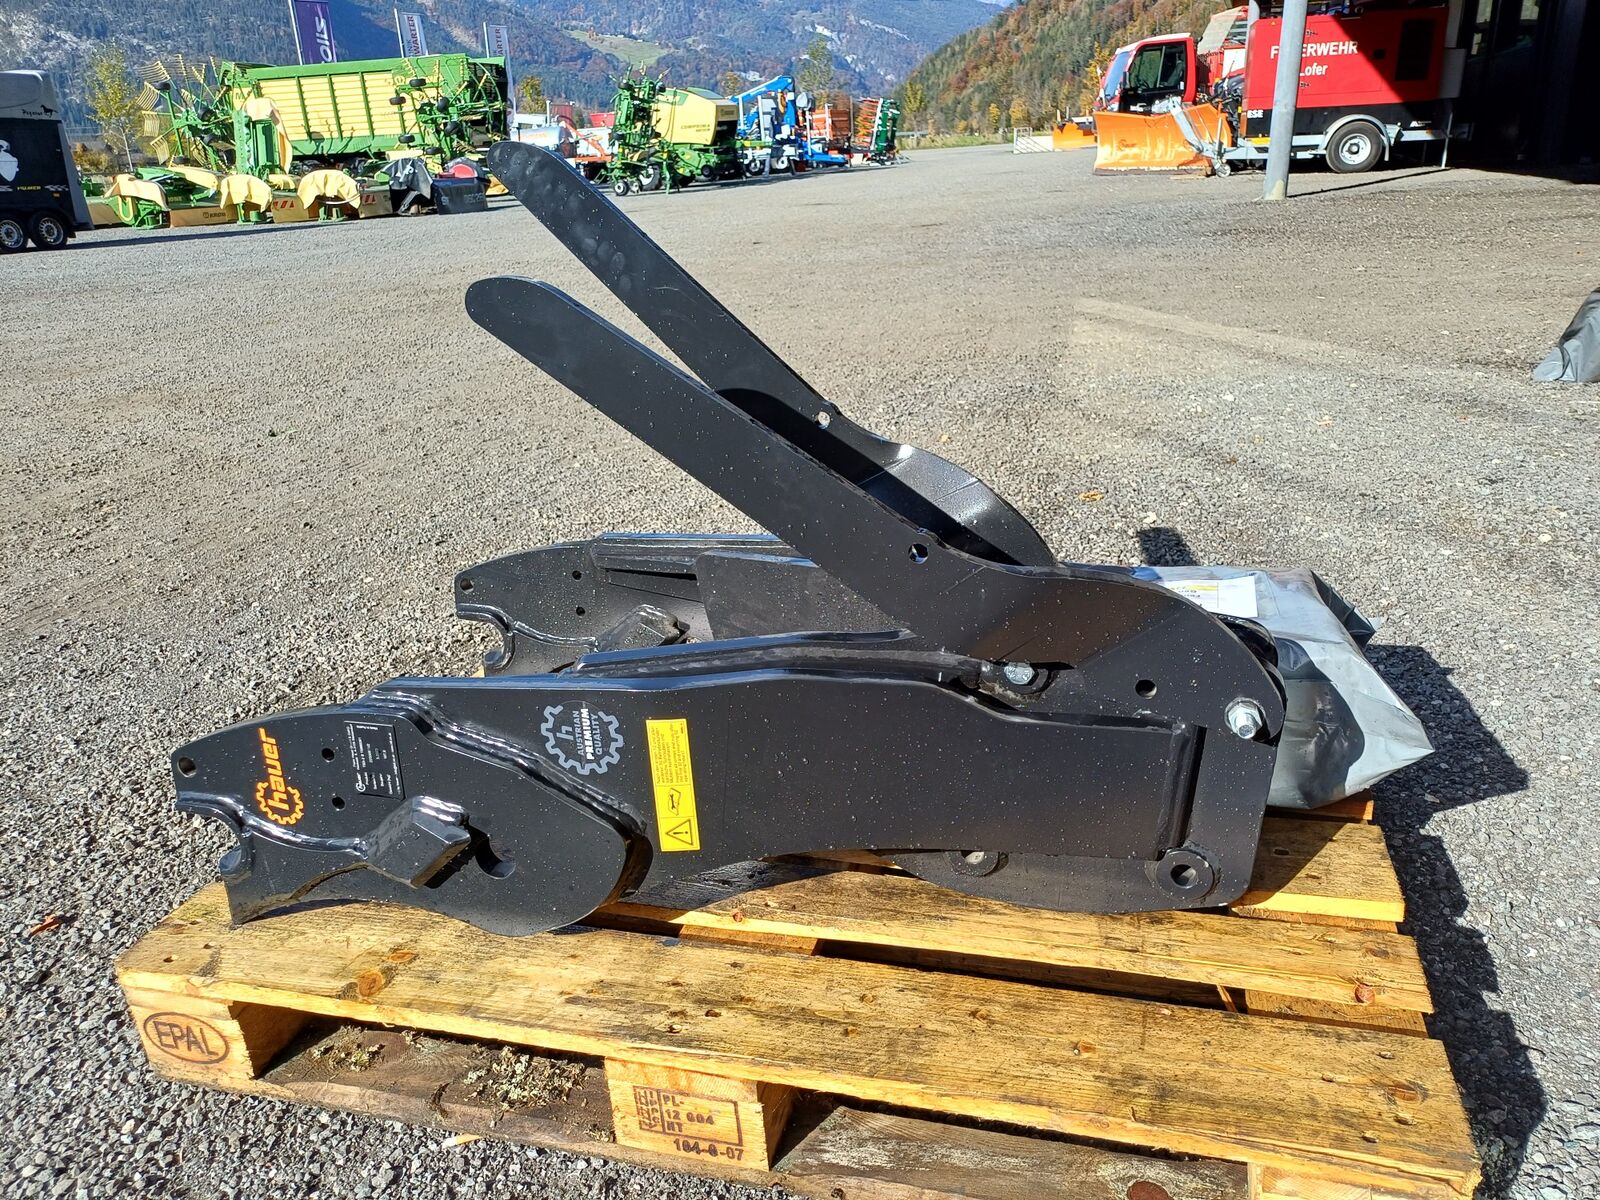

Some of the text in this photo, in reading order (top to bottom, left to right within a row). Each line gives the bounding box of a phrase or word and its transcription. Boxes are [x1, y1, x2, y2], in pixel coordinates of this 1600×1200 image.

[572, 710, 585, 756] AUSTRIAN
[580, 708, 594, 760] PREMIUM
[590, 713, 603, 755] QUALITY
[258, 727, 290, 811] hauer
[152, 1020, 220, 1057] EPAL
